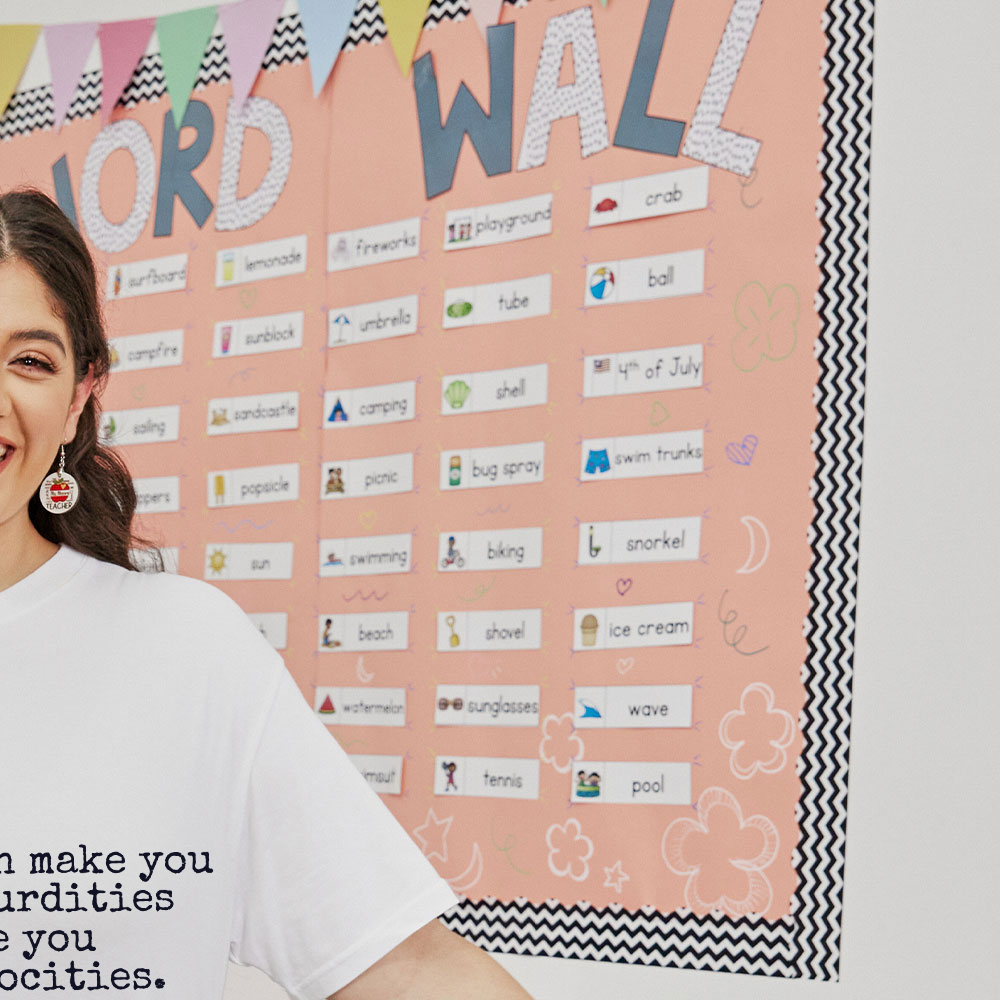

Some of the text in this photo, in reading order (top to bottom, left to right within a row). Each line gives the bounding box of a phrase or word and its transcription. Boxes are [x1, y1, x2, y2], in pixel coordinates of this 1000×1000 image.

[413, 0, 764, 200] WALL
[645, 184, 683, 207] crab
[475, 207, 552, 238] playground
[356, 232, 417, 258] fireworks
[245, 251, 302, 273] lemonade
[128, 266, 186, 289] surfboard
[648, 265, 674, 288] ball
[498, 292, 529, 312] tube
[359, 310, 411, 334] umbrella
[245, 324, 296, 346] sunblock
[127, 343, 178, 364] campfire
[645, 358, 664, 379] of
[669, 356, 702, 379] July
[496, 379, 526, 400] shell
[234, 402, 297, 422] sandcastle
[359, 397, 408, 418] camping
[133, 418, 166, 438] sailing
[614, 443, 703, 466] swim trunks
[364, 469, 398, 488] picnic
[472, 459, 541, 484] bug spray
[240, 478, 290, 498] popsicle
[487, 541, 525, 562] biking
[626, 529, 685, 553] snorkel
[250, 557, 271, 571] sun
[349, 548, 408, 568] swimming
[358, 623, 394, 643] beach
[485, 620, 526, 642] shovel
[609, 619, 690, 639] ice cream
[343, 699, 405, 715] watermelon
[467, 697, 540, 718] sunglasses
[628, 703, 669, 718] wave
[483, 772, 523, 789] tennis
[632, 773, 666, 798] pool
[28, 844, 127, 876] make
[138, 848, 215, 883] you
[20, 927, 98, 961] you
